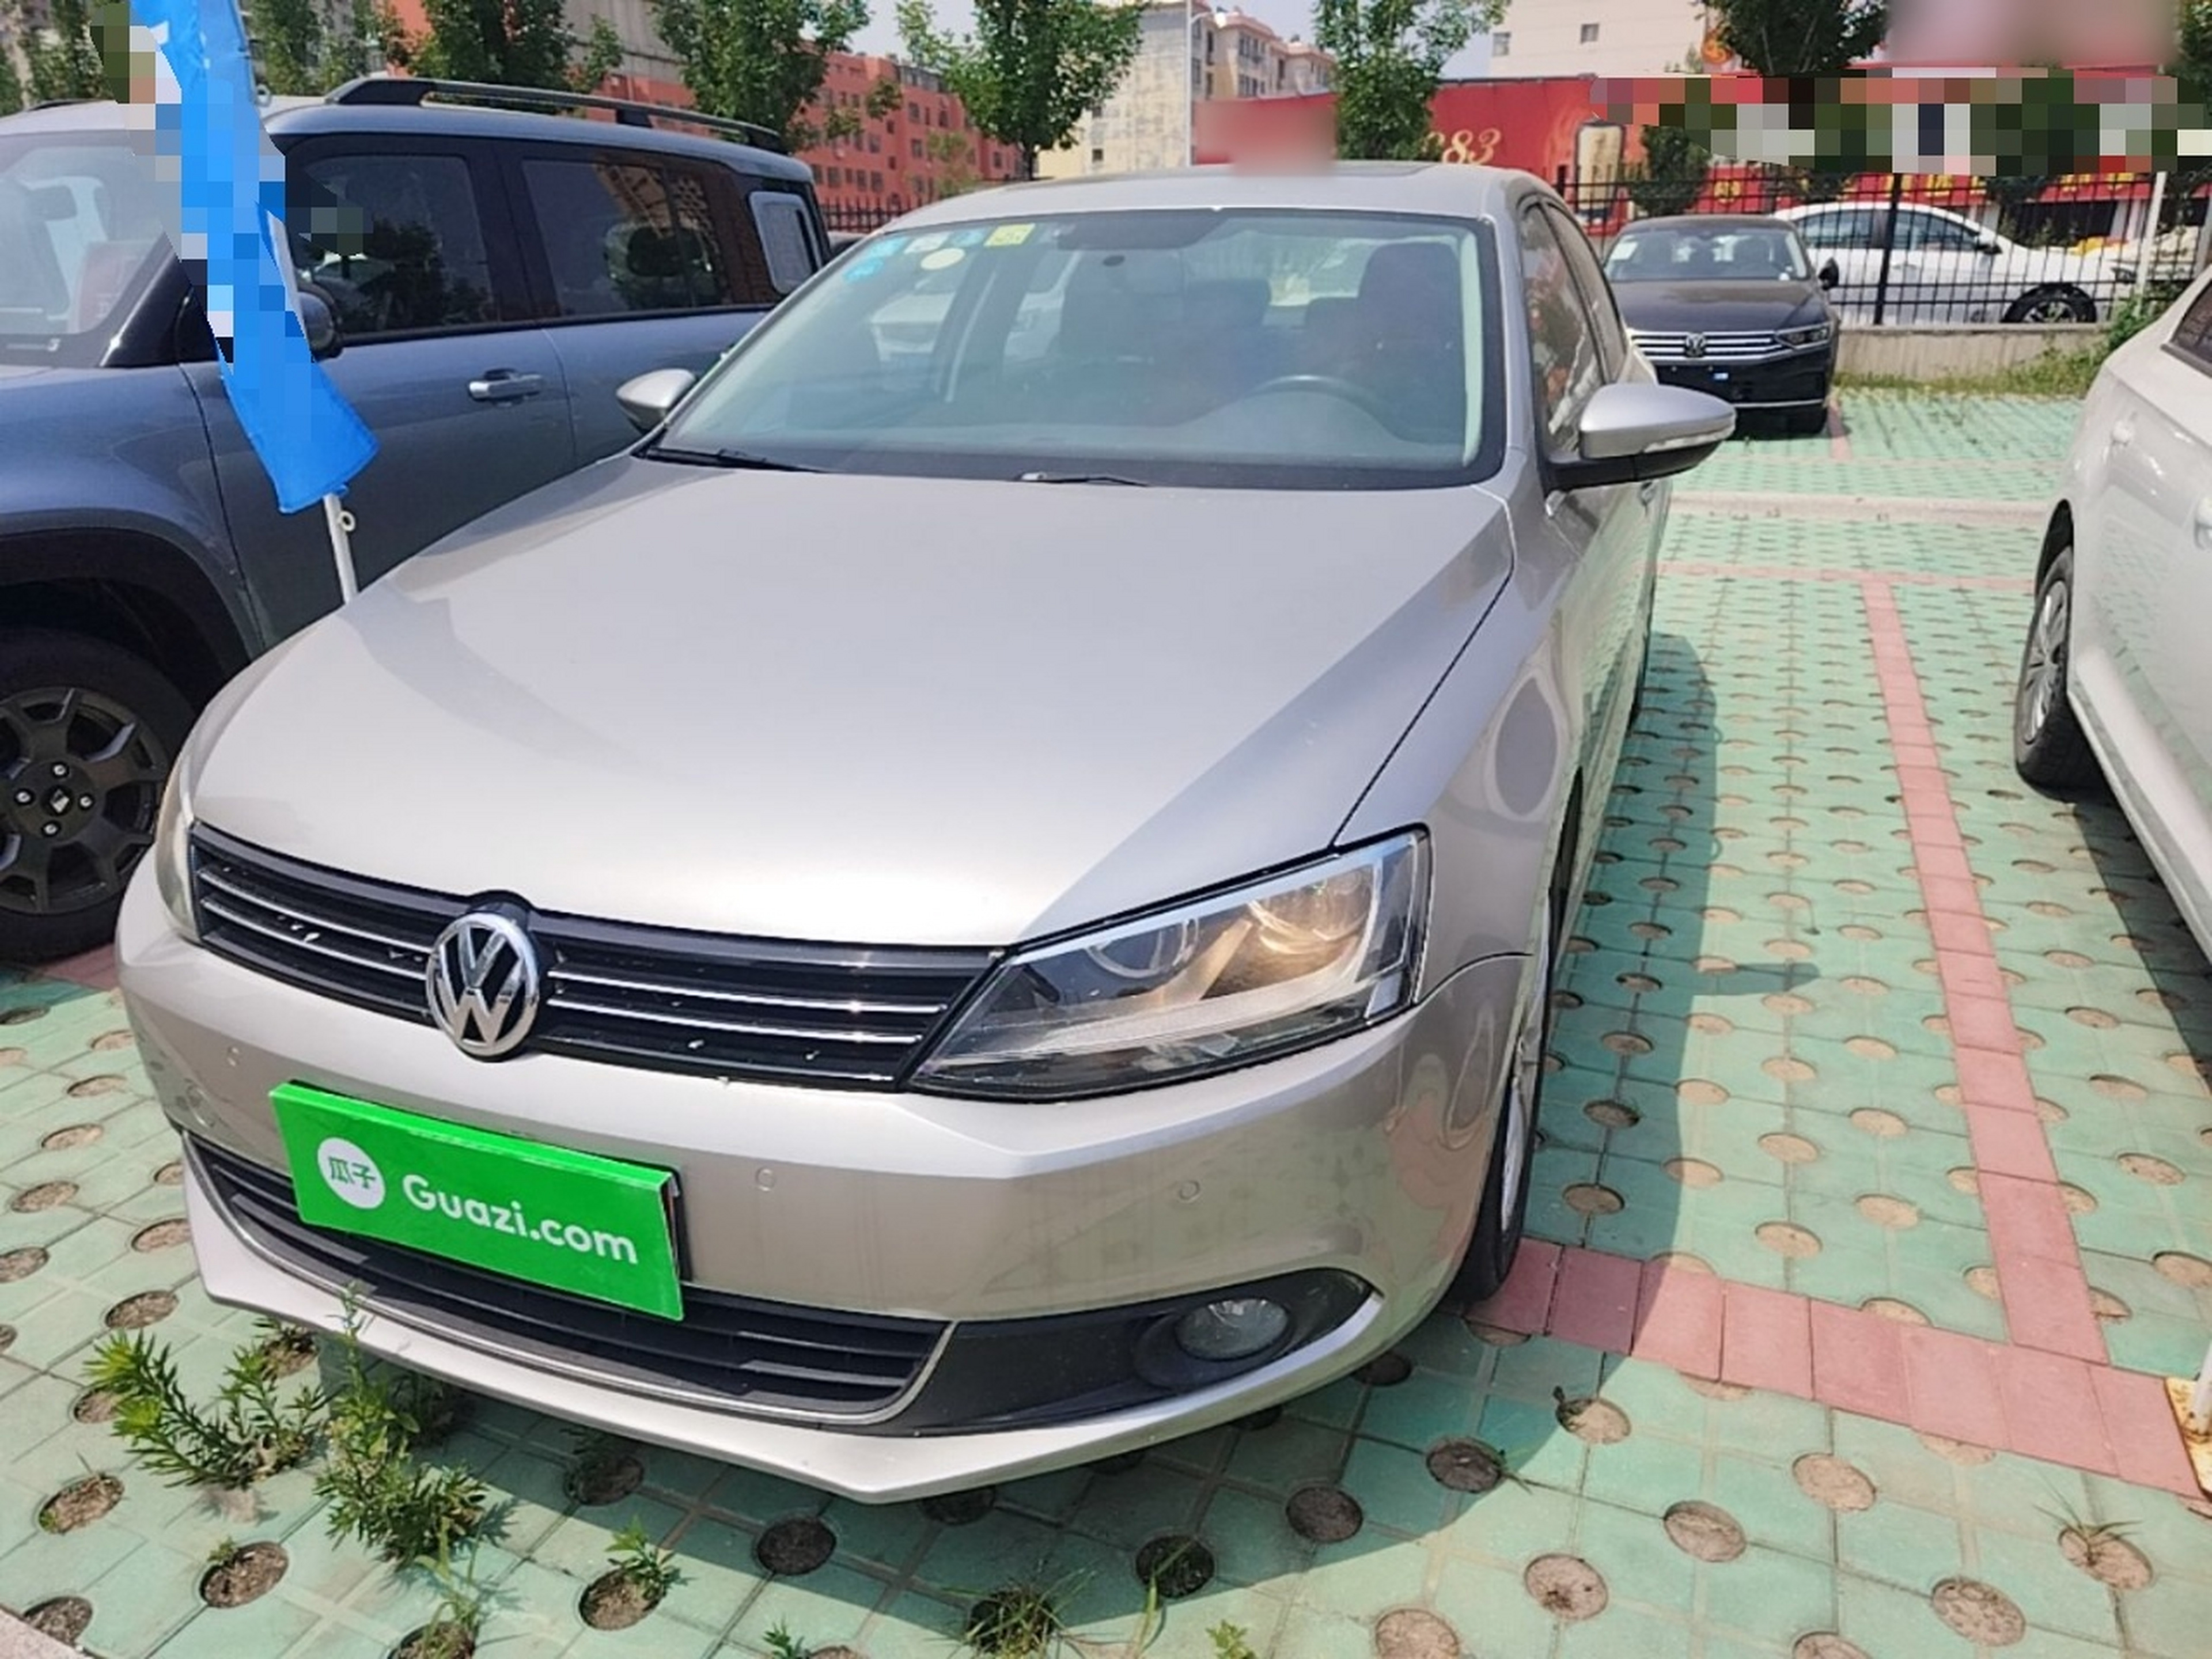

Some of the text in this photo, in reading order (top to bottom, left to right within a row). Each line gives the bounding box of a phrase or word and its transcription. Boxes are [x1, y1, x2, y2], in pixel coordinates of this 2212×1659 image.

[430, 916, 535, 1053] VW
[328, 1156, 376, 1189] 瓜子
[403, 1174, 637, 1264] Guazi.com
